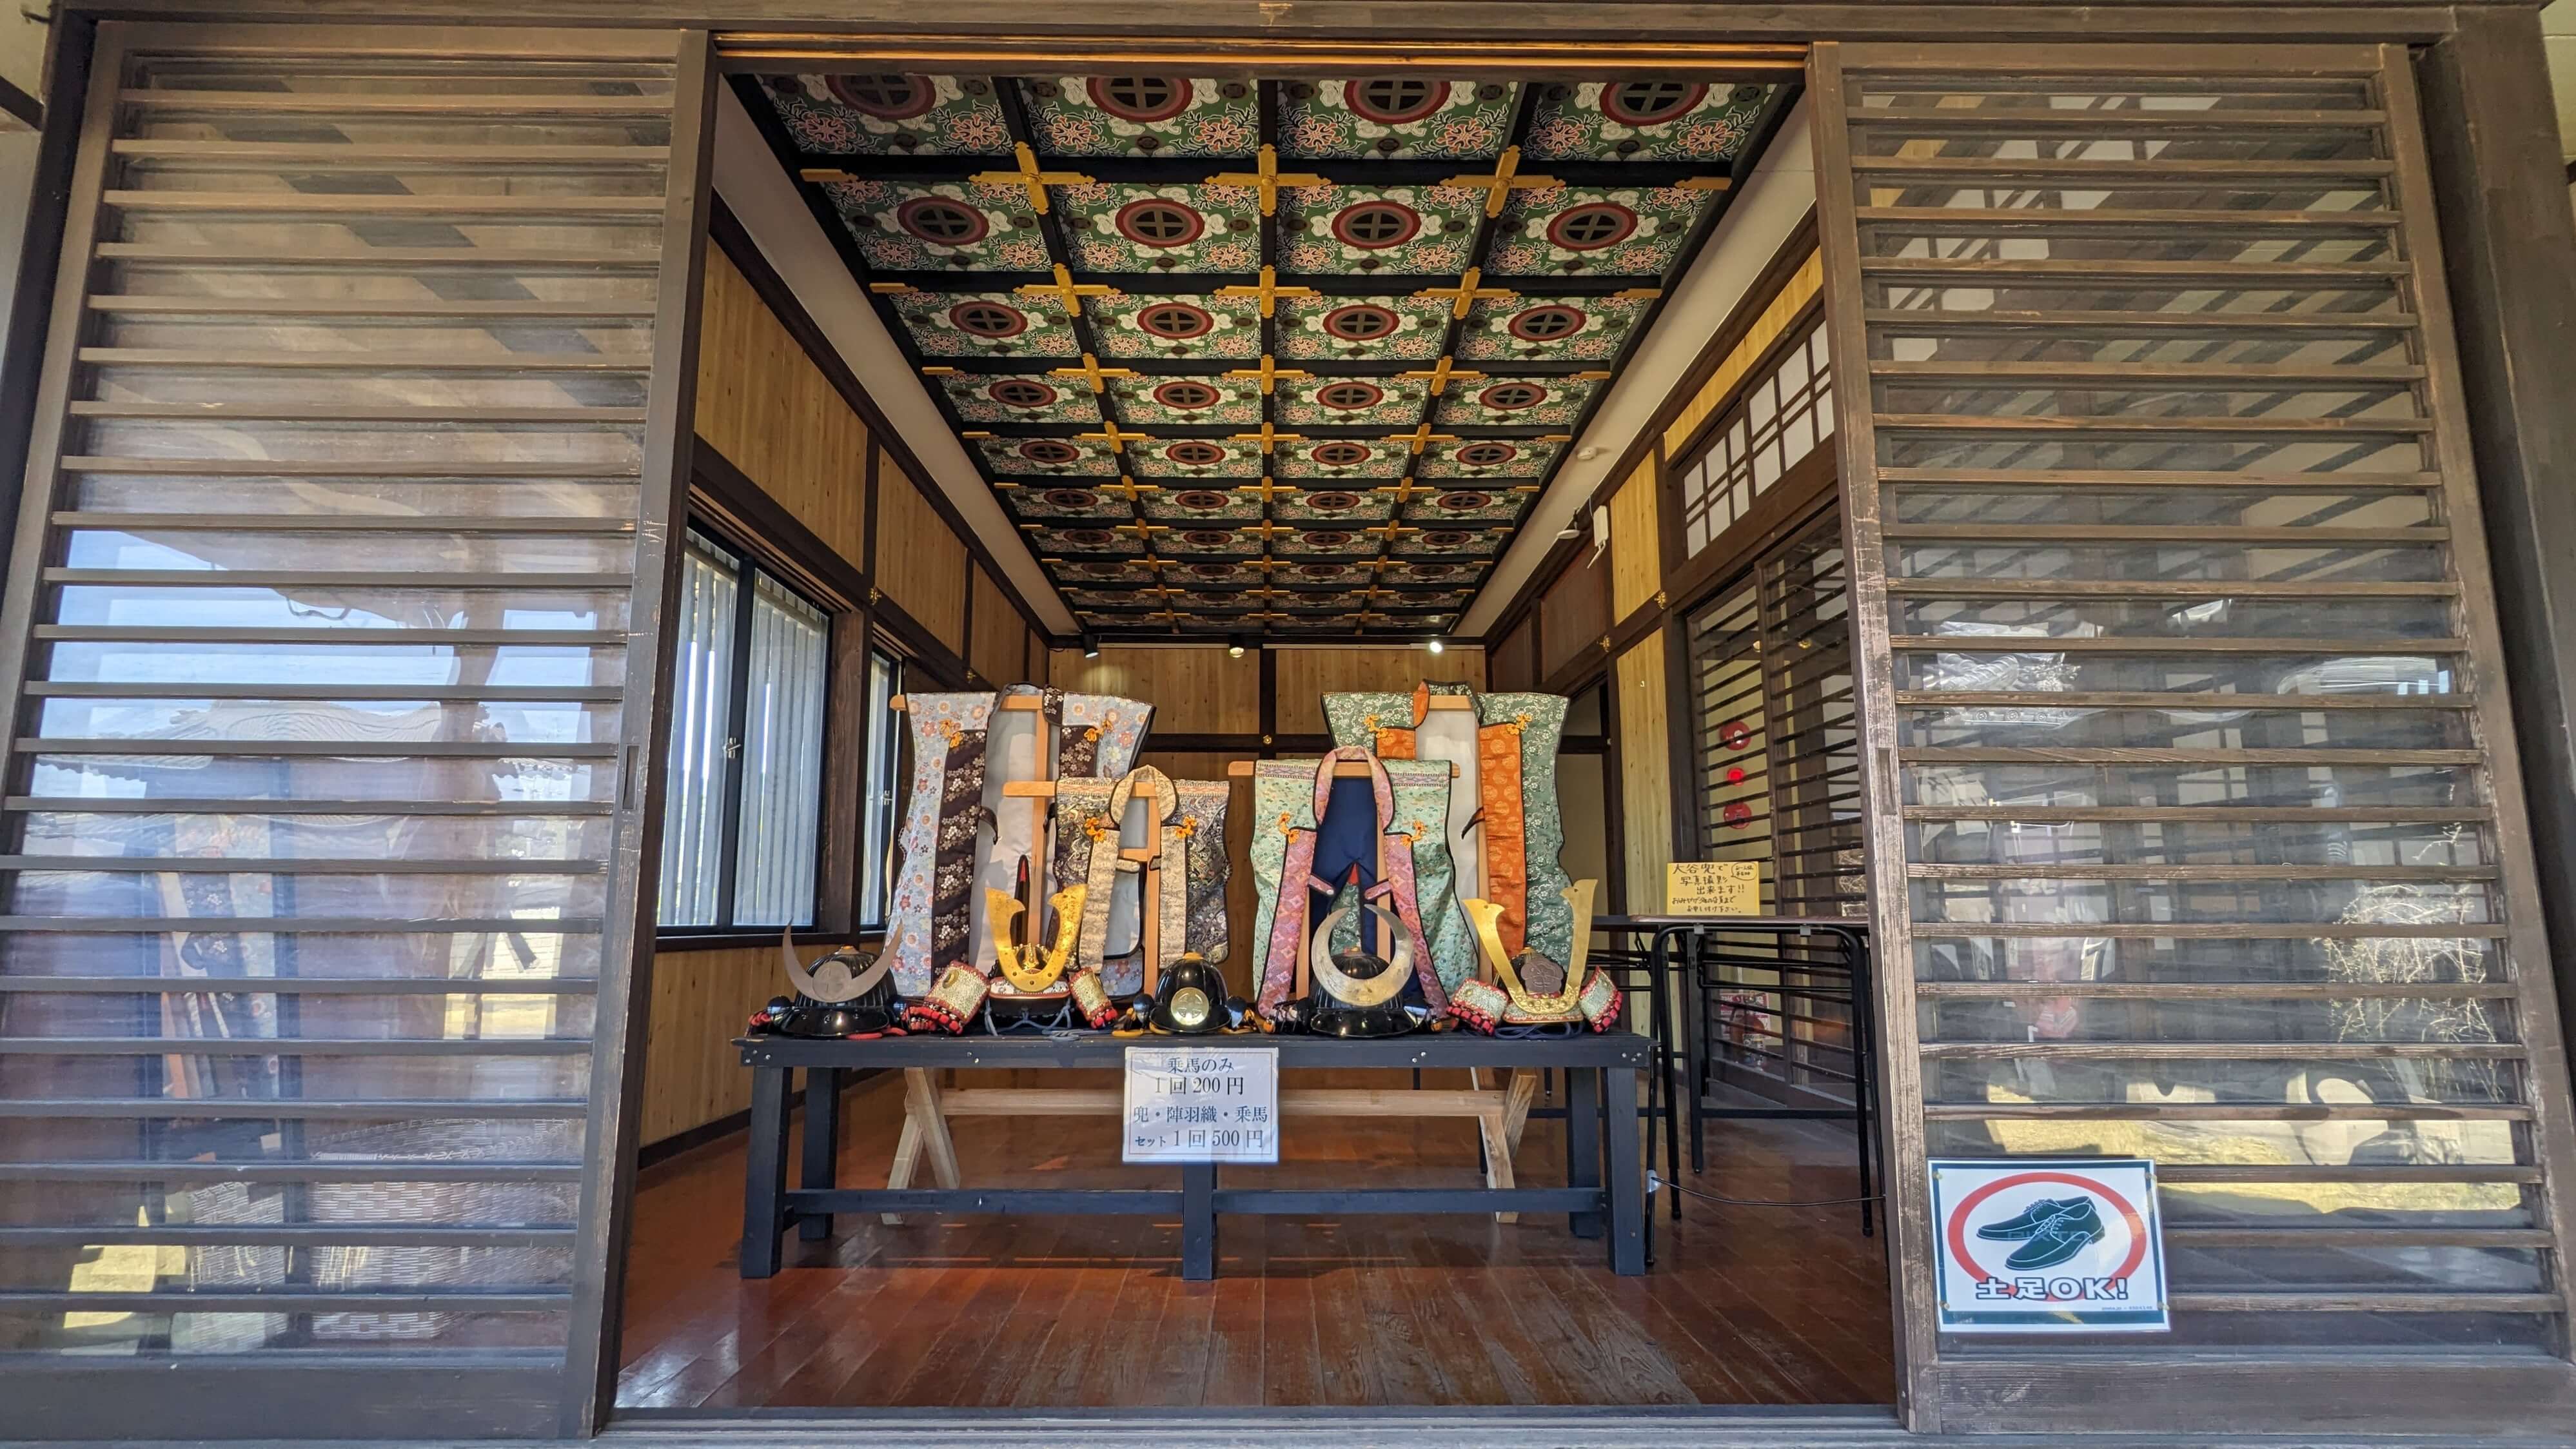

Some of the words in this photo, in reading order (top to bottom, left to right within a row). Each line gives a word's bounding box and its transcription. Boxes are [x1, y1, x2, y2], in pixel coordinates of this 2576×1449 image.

[1680, 875, 1728, 887] 写真撮影
[1168, 1058, 1234, 1073] 乗馬のみ
